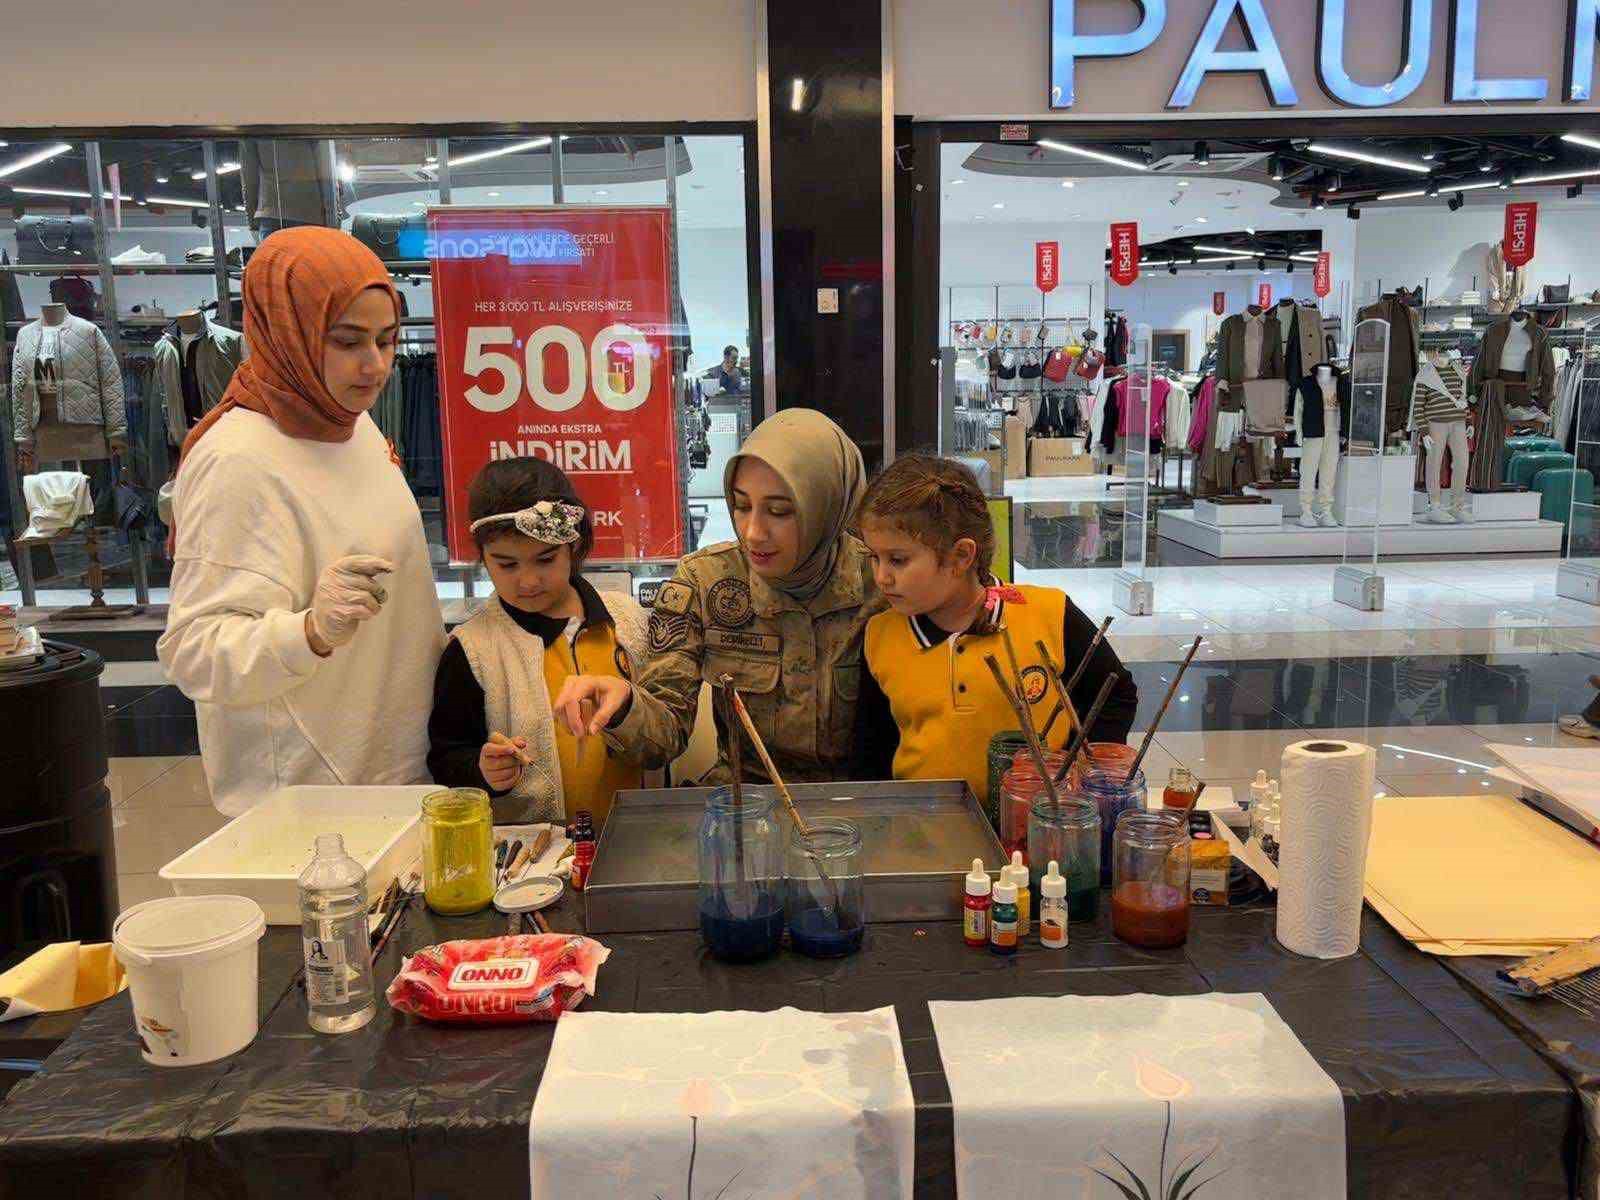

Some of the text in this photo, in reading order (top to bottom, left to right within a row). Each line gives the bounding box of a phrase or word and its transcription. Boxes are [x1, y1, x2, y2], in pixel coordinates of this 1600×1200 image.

[1050, 0, 1600, 108] PAUL
[474, 301, 497, 312] HER
[498, 301, 529, 312] 3.000
[532, 300, 545, 312] TL
[463, 323, 651, 413] 500
[517, 424, 603, 434] ANINDA EKSTRA
[461, 966, 524, 982] ONNO
